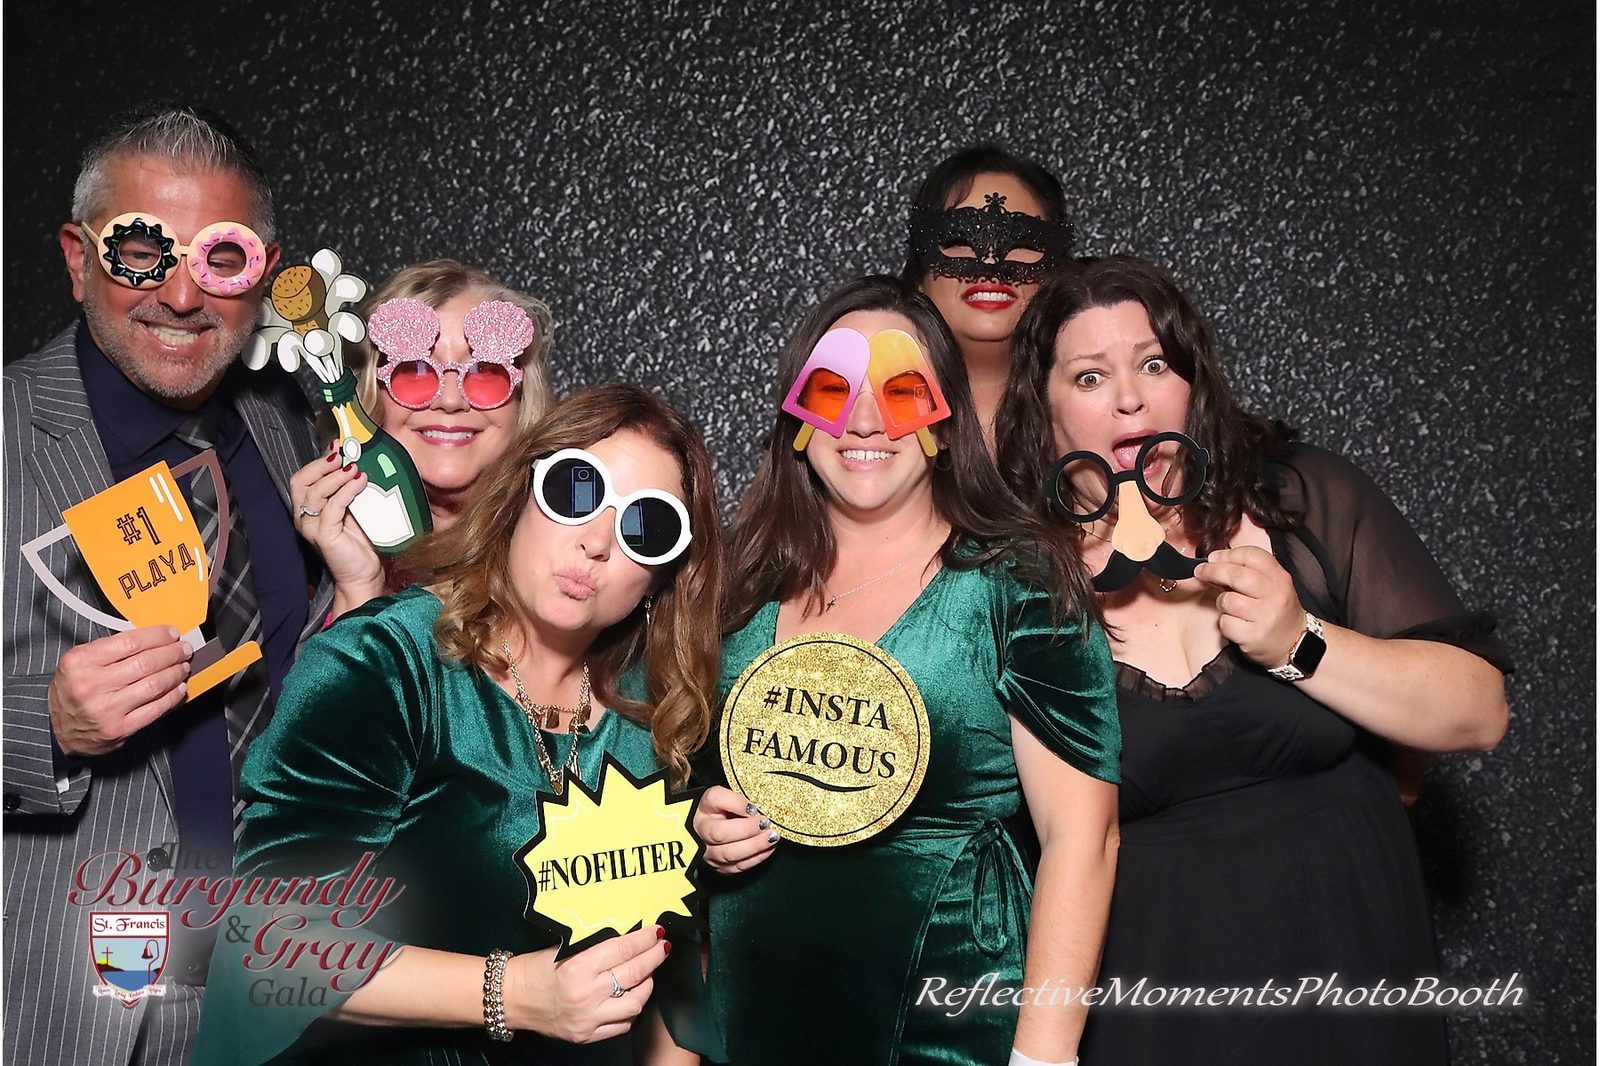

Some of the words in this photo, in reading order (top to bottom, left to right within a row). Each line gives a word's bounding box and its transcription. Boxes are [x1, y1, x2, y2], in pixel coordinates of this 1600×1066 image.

[116, 506, 161, 546] #1
[118, 543, 196, 600] PLAYA
[763, 684, 891, 731] #INSTA
[741, 727, 898, 779] FAMOUS
[538, 839, 688, 892] #NOFILTER
